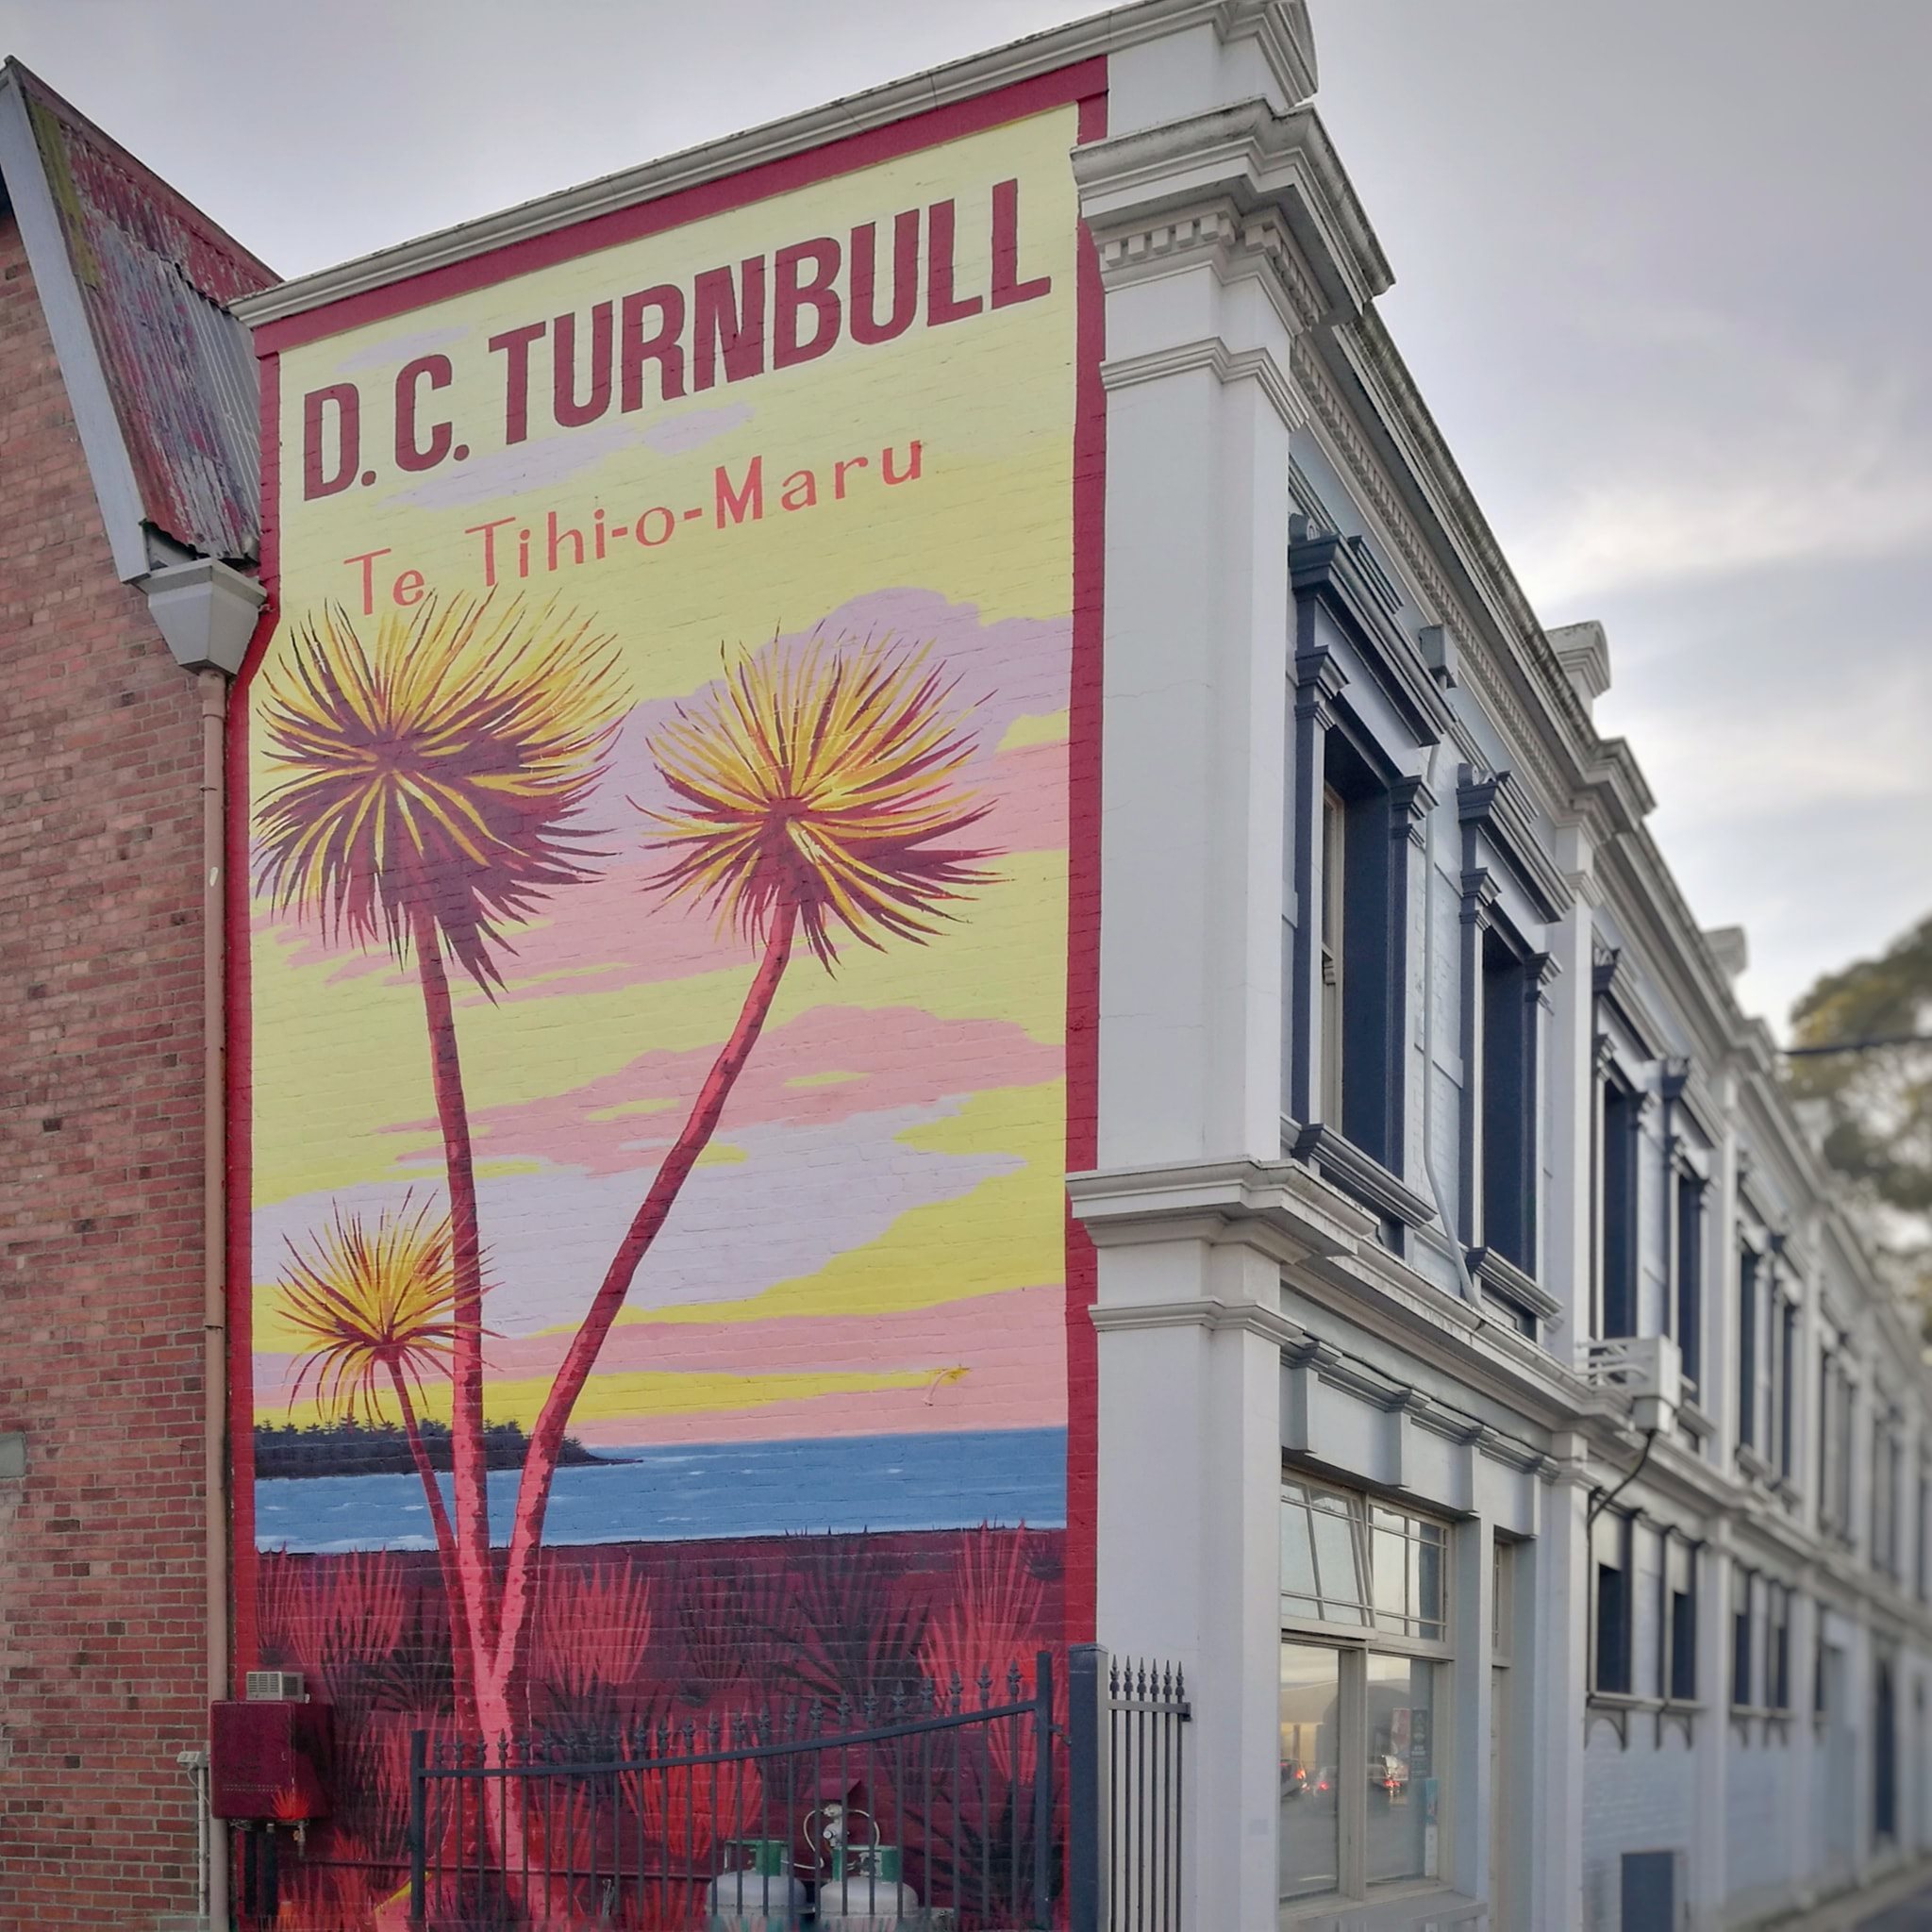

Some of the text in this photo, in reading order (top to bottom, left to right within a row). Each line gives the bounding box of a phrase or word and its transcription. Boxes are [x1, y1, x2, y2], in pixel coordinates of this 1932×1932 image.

[488, 178, 1052, 445] TURNBULL
[343, 440, 923, 616] Te Tihi-o-Maru
